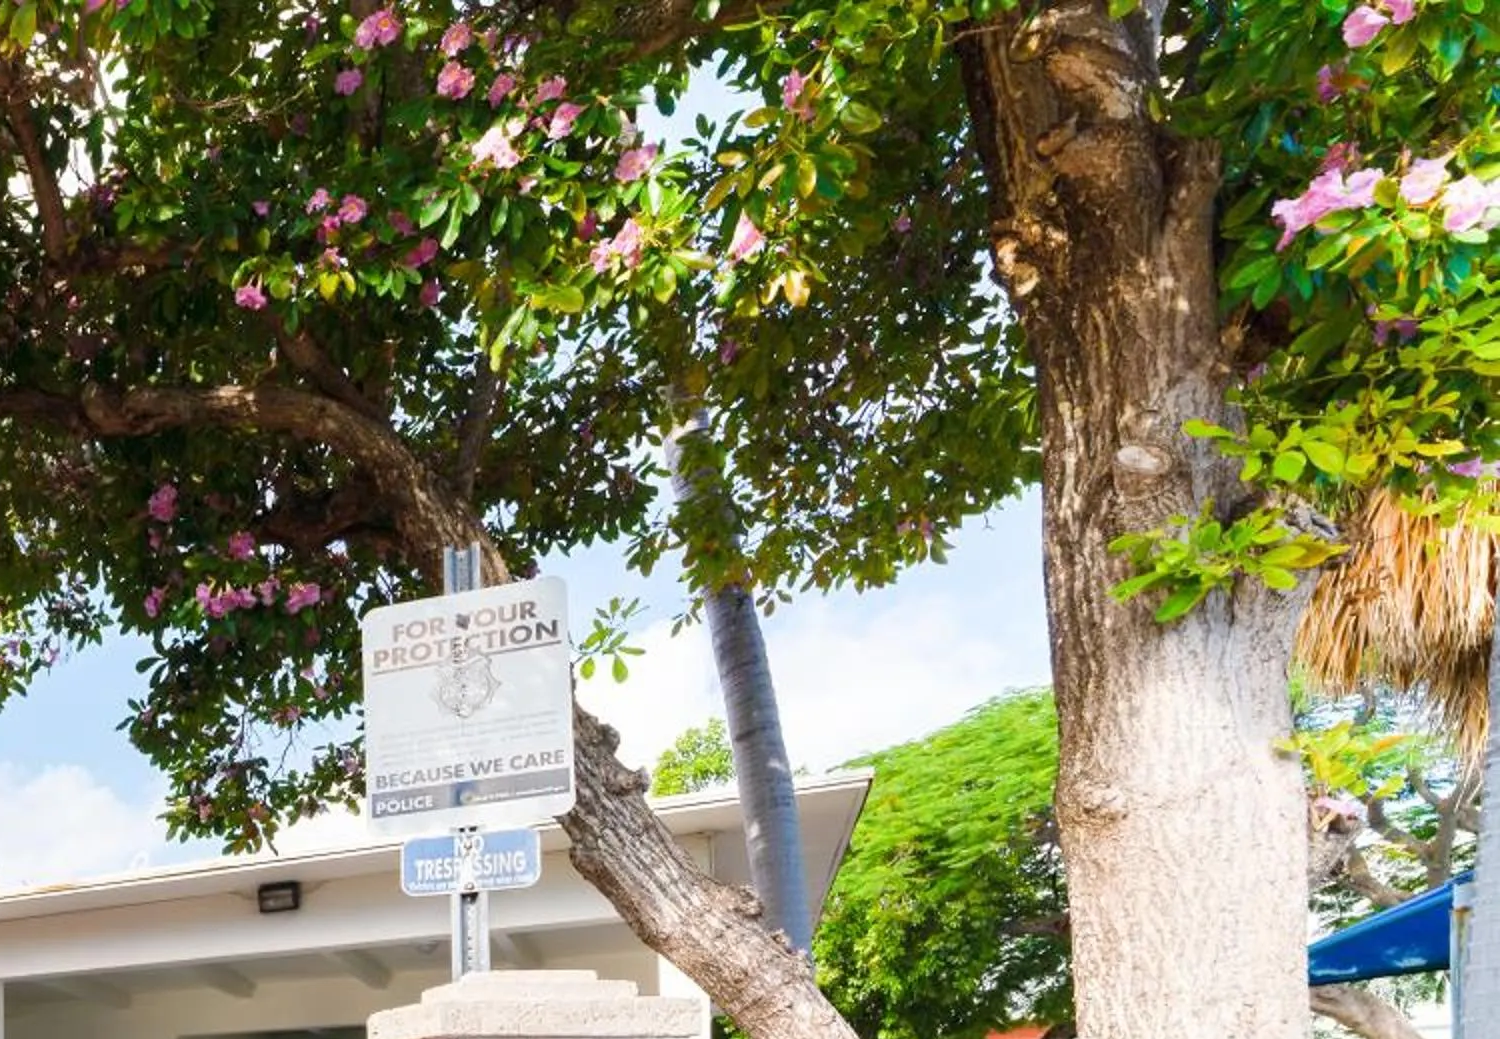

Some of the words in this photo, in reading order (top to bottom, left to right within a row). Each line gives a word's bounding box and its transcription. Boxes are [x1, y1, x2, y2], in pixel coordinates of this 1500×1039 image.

[392, 617, 446, 642] FOR
[373, 620, 559, 669] PROTECTION
[375, 763, 465, 790] BECAUSE
[469, 757, 505, 776] WE
[509, 749, 565, 770] CARE
[375, 795, 434, 815] POLICE
[454, 835, 485, 857] NO
[414, 851, 526, 881] TRESPSSING
